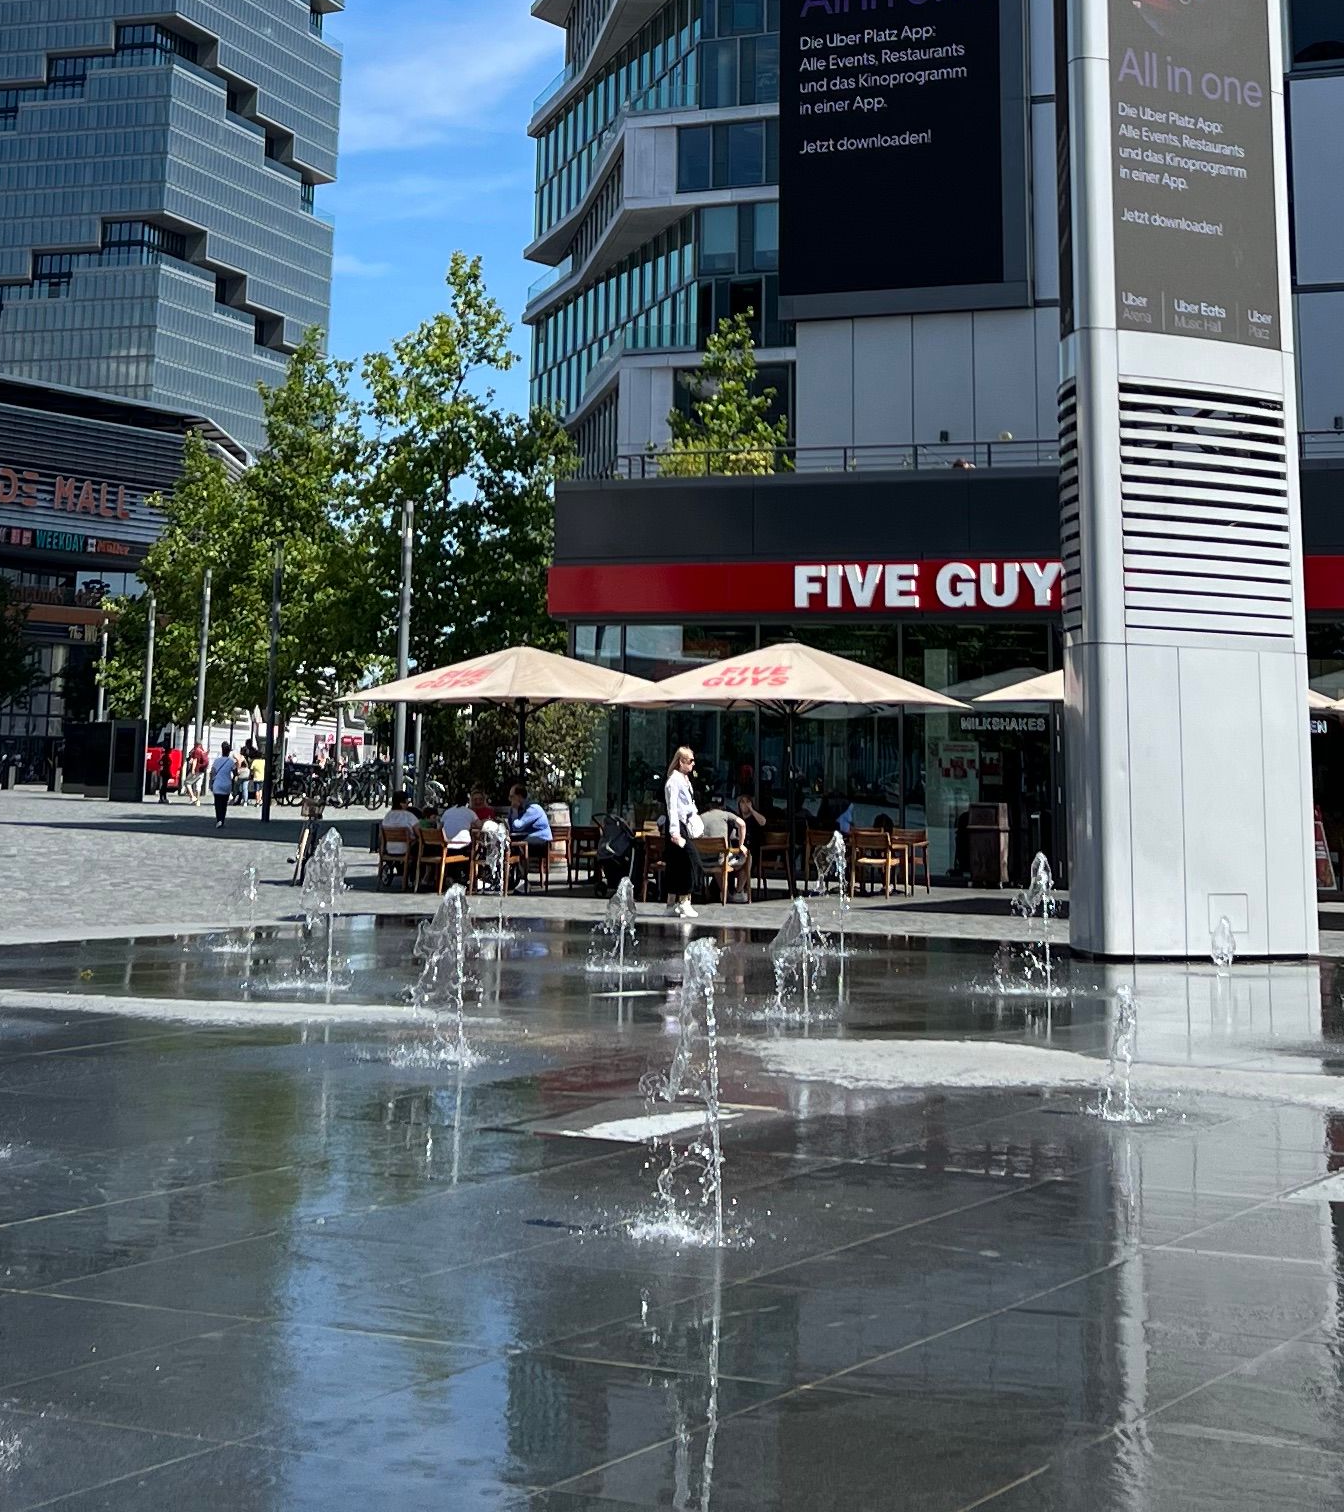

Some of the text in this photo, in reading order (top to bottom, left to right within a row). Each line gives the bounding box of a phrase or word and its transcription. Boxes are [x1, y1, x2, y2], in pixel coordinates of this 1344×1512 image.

[800, 25, 936, 50] Die Uber Platz App:
[799, 43, 965, 72] Alle Events, Restaurants
[800, 66, 967, 93] und das Kinoprogramm
[1118, 47, 1263, 108] All in one
[800, 96, 887, 115] in einer App.
[1118, 102, 1224, 134] Die Uber Platz App:
[800, 129, 932, 154] Jetzt downloaden!
[1119, 124, 1245, 158] Alle Events, Restaurants
[1119, 146, 1247, 178] und das Kinoprogramm
[1119, 165, 1189, 191] in einer App.
[1121, 208, 1223, 236] Jetzt downloaden!
[1122, 291, 1148, 307] Uber
[1174, 299, 1226, 318] Uber Eats
[1248, 309, 1272, 325] Uber
[54, 475, 129, 520] MALL
[36, 529, 85, 552] WEEKDAY
[794, 562, 1065, 608] FIVE GUY
[703, 677, 789, 687] GUYS
[720, 666, 792, 676] FIVE
[960, 717, 1046, 731] MILKSHAKES
